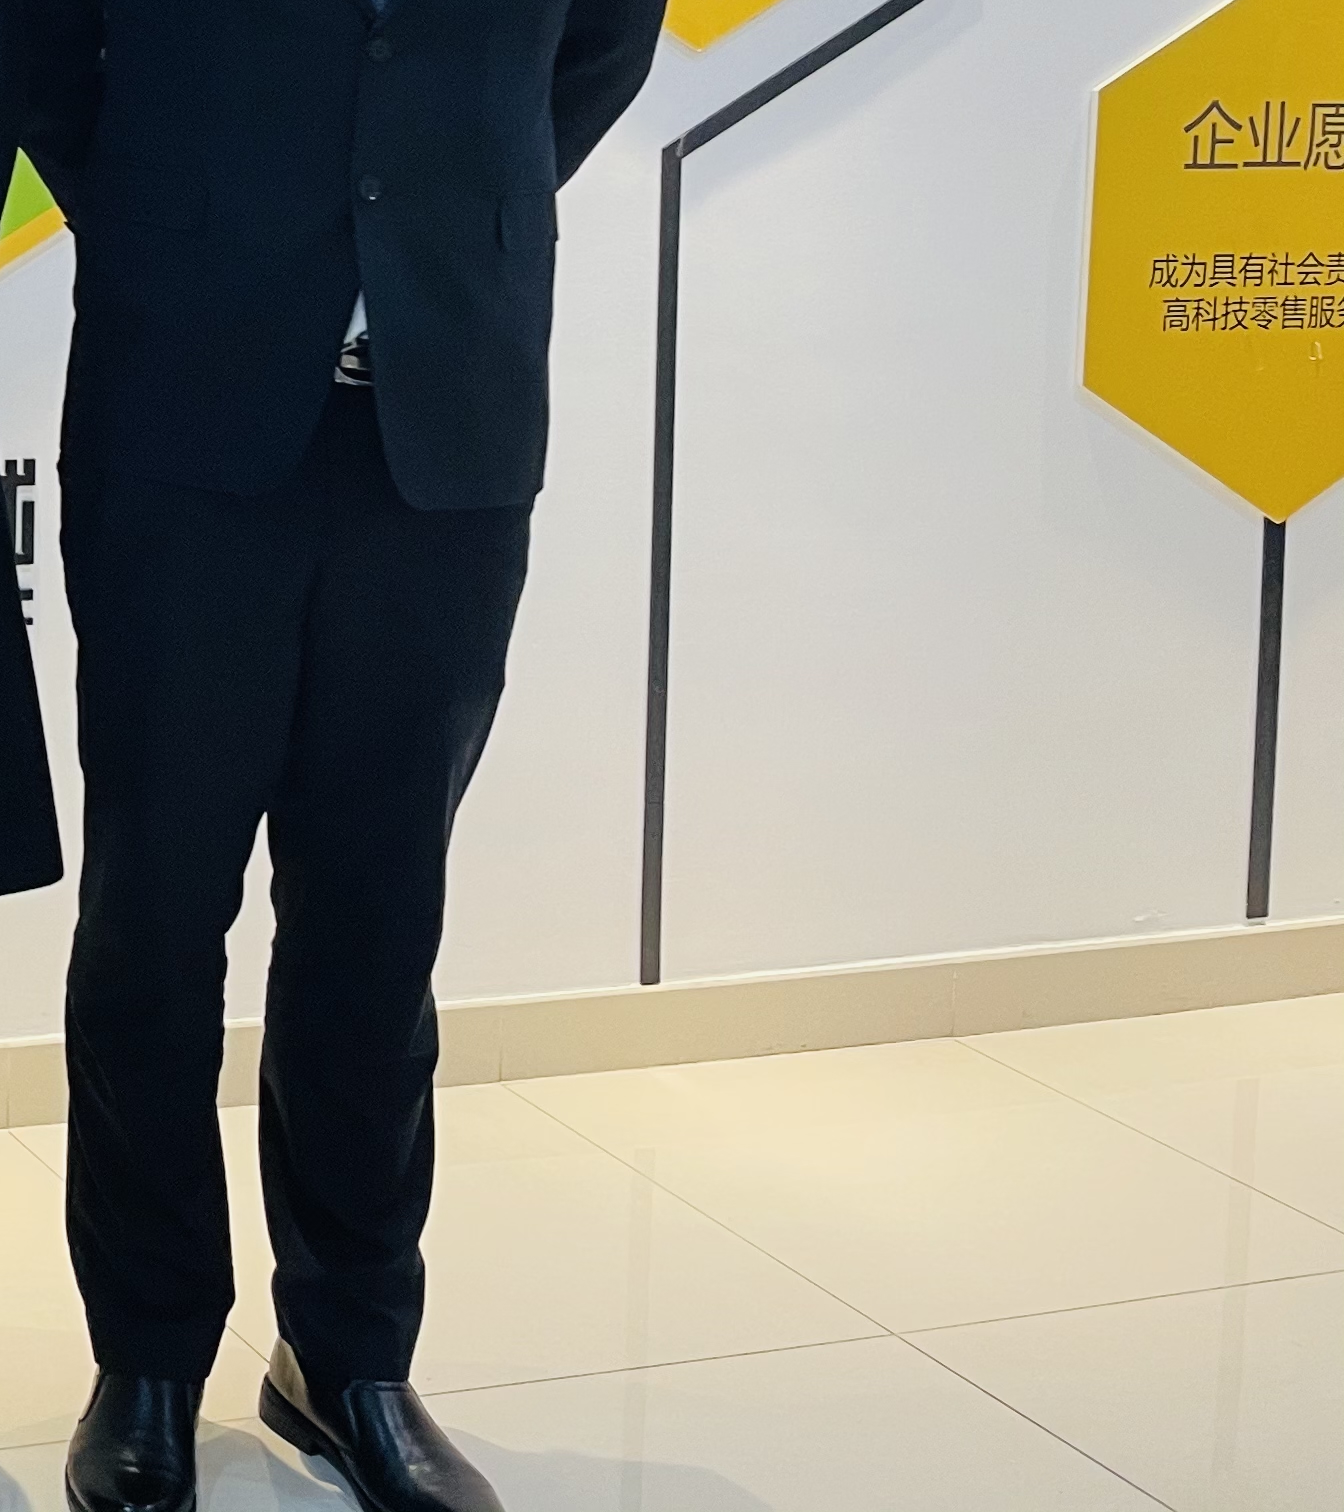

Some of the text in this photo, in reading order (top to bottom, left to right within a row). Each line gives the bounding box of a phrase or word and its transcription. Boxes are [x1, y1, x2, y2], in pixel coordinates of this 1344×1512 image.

[1182, 99, 1344, 172] 企业愿
[1162, 294, 1344, 333] 高科技零售服
